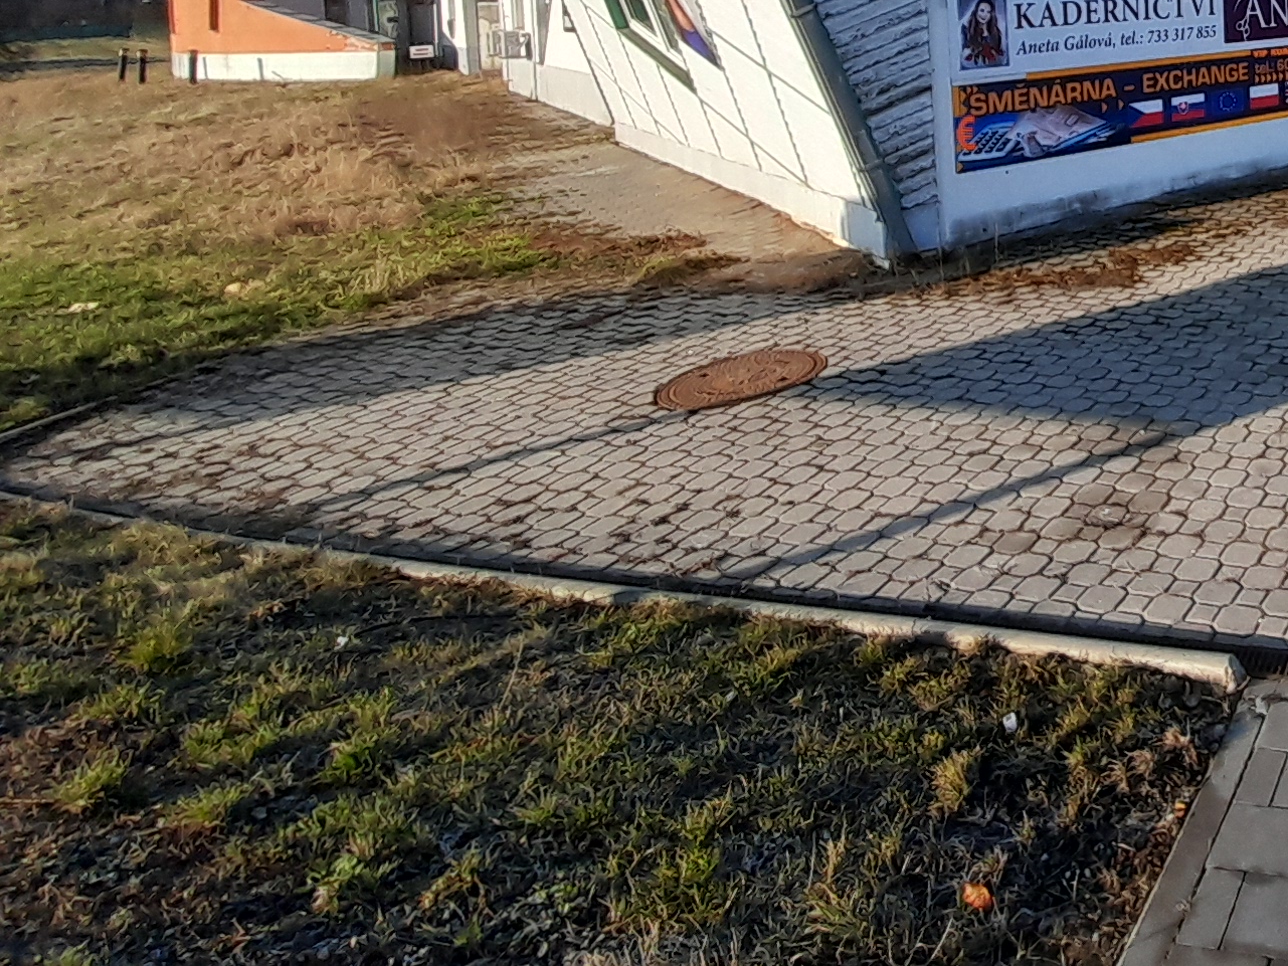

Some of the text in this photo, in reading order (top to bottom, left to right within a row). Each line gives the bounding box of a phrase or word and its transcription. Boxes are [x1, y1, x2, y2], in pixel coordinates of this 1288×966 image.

[1016, 24, 1217, 56] Aneta Gálová, tel.: 733 317 855
[970, 77, 1117, 116] SMĚNÁRNA
[1142, 62, 1249, 94] EXCHANGE
